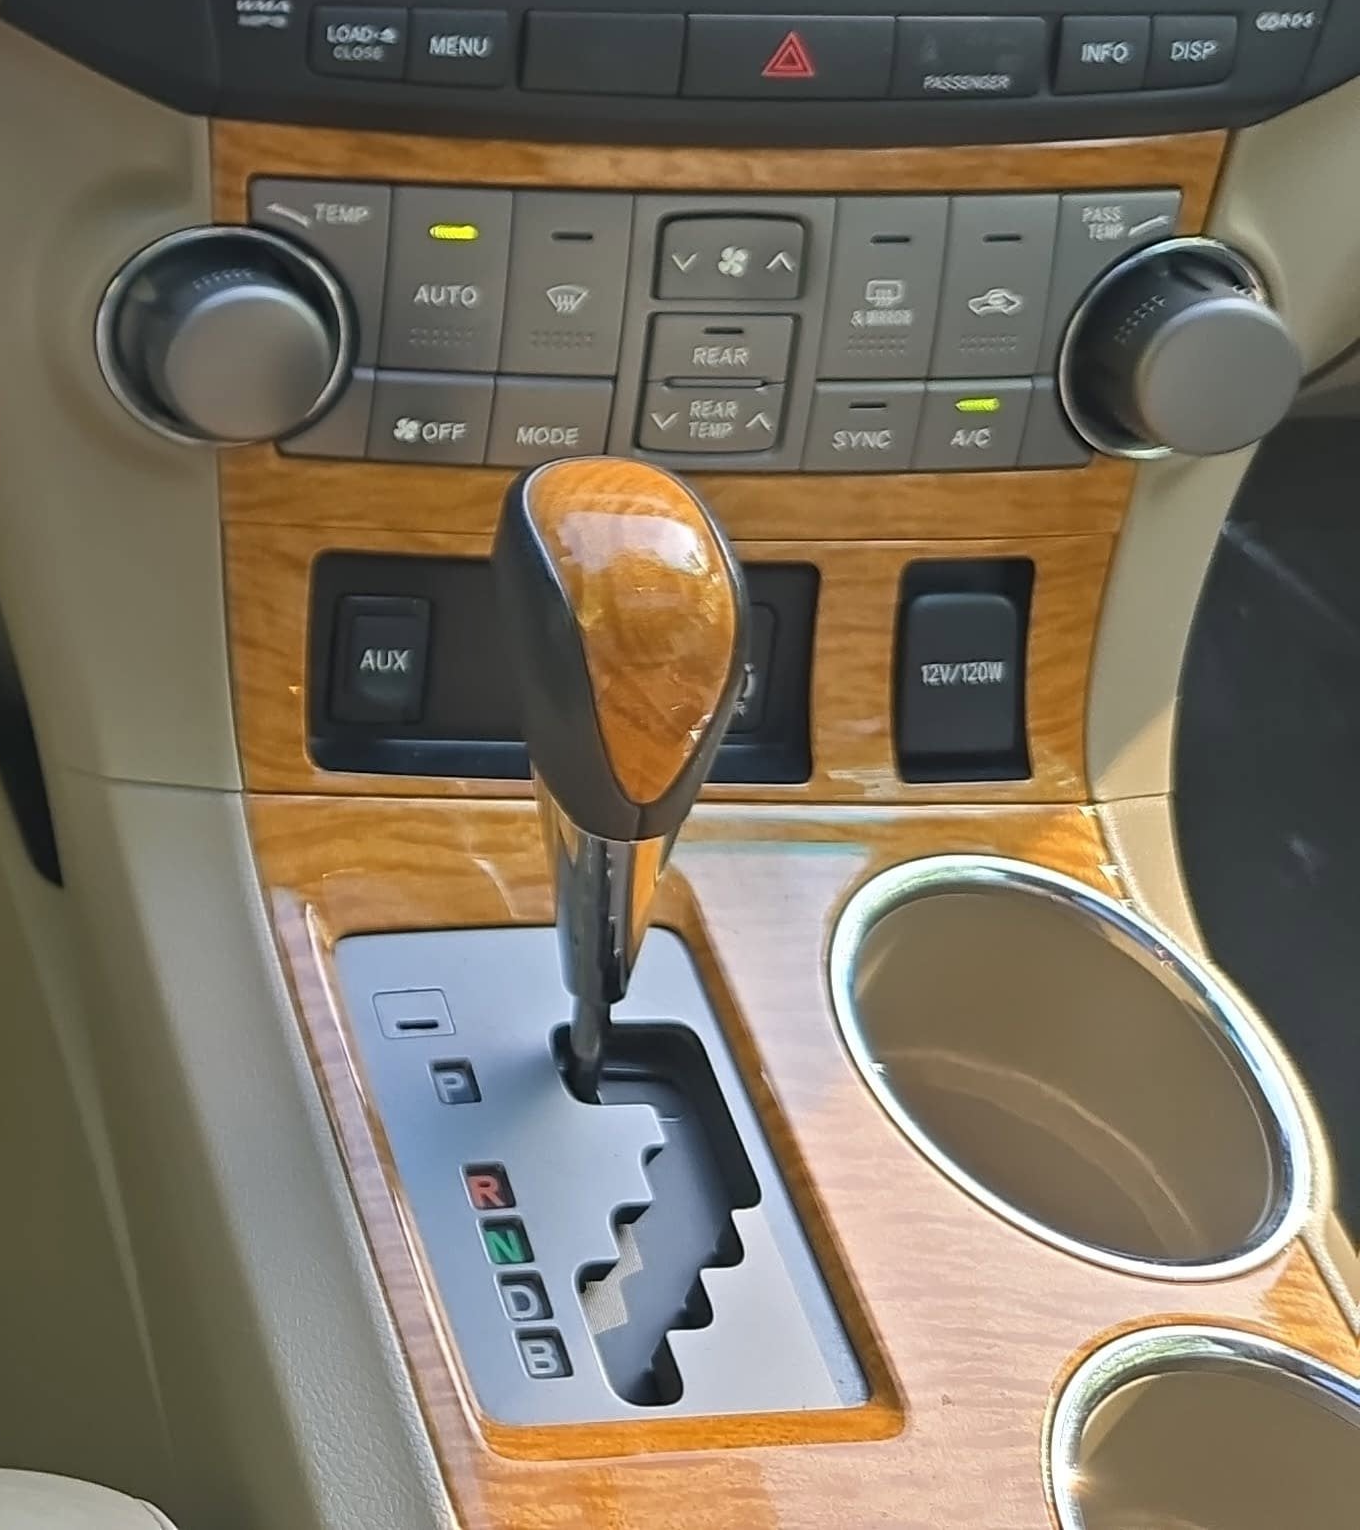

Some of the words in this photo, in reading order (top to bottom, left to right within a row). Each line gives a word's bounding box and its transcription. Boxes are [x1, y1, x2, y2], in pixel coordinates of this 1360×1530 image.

[326, 24, 374, 43] LOAD
[333, 45, 383, 61] CLOSE
[429, 34, 489, 57] MENU
[1081, 42, 1128, 63] INFO
[1169, 40, 1218, 62] DISP
[923, 74, 1011, 93] PASSENGER
[313, 203, 371, 224] TEMP
[1081, 206, 1122, 223] PASS
[1088, 222, 1124, 241] TEMP
[413, 285, 478, 307] AUTO
[692, 345, 750, 366] REAR
[690, 400, 738, 420] REAR
[422, 422, 468, 442] OFF
[516, 425, 580, 447] MODE
[688, 419, 735, 440] TEMP
[832, 429, 893, 450] SYNC
[950, 425, 991, 449] A/C
[359, 648, 408, 673] AUX
[920, 660, 1004, 686] 12V/120W
[440, 1072, 467, 1102] P
[470, 1175, 504, 1206] R
[483, 1231, 527, 1265] N
[503, 1283, 543, 1319] D
[521, 1337, 559, 1376] B
